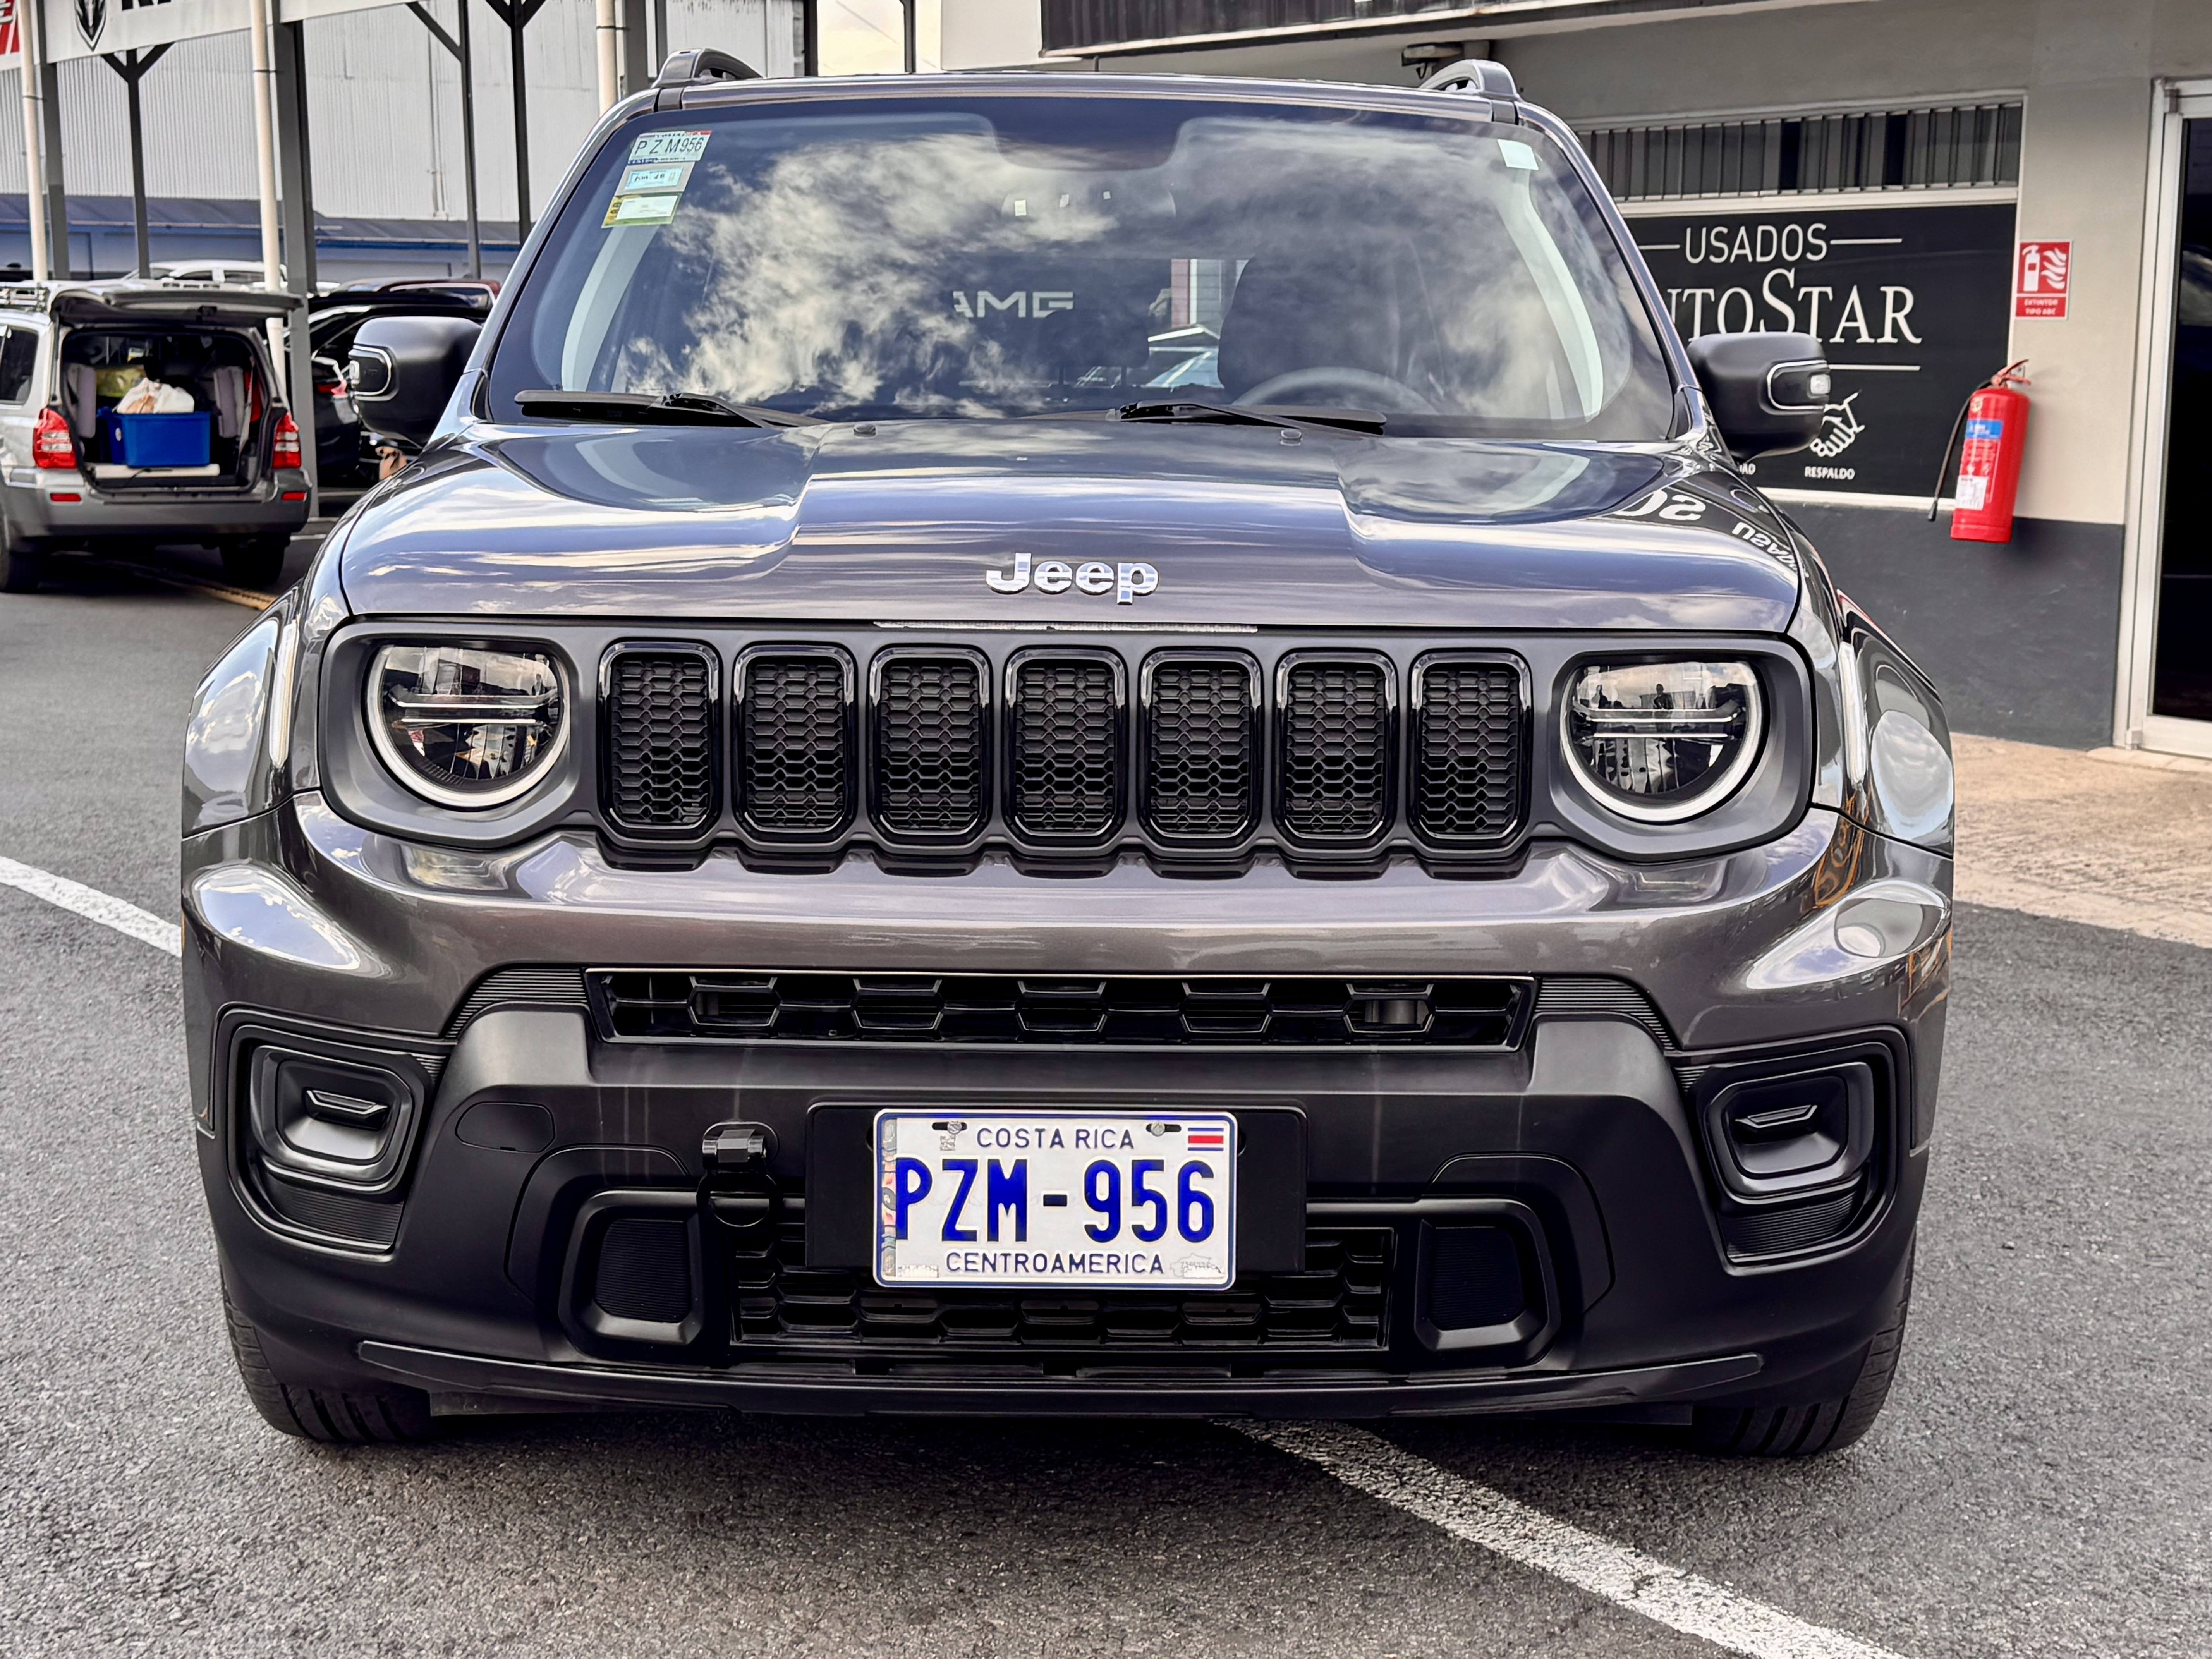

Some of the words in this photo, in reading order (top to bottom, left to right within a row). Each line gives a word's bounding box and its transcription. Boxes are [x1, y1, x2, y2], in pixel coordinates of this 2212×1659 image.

[1685, 223, 1827, 264] USADOS
[953, 291, 1074, 318] AMG
[1804, 466, 1856, 480] RESPALDO
[986, 552, 1159, 605] Jeep
[976, 1128, 1065, 1149] COSTA
[1075, 1128, 1134, 1150] RICA
[895, 1156, 1215, 1243] PZM-956
[946, 1252, 1164, 1274] CENTROAMERICA
